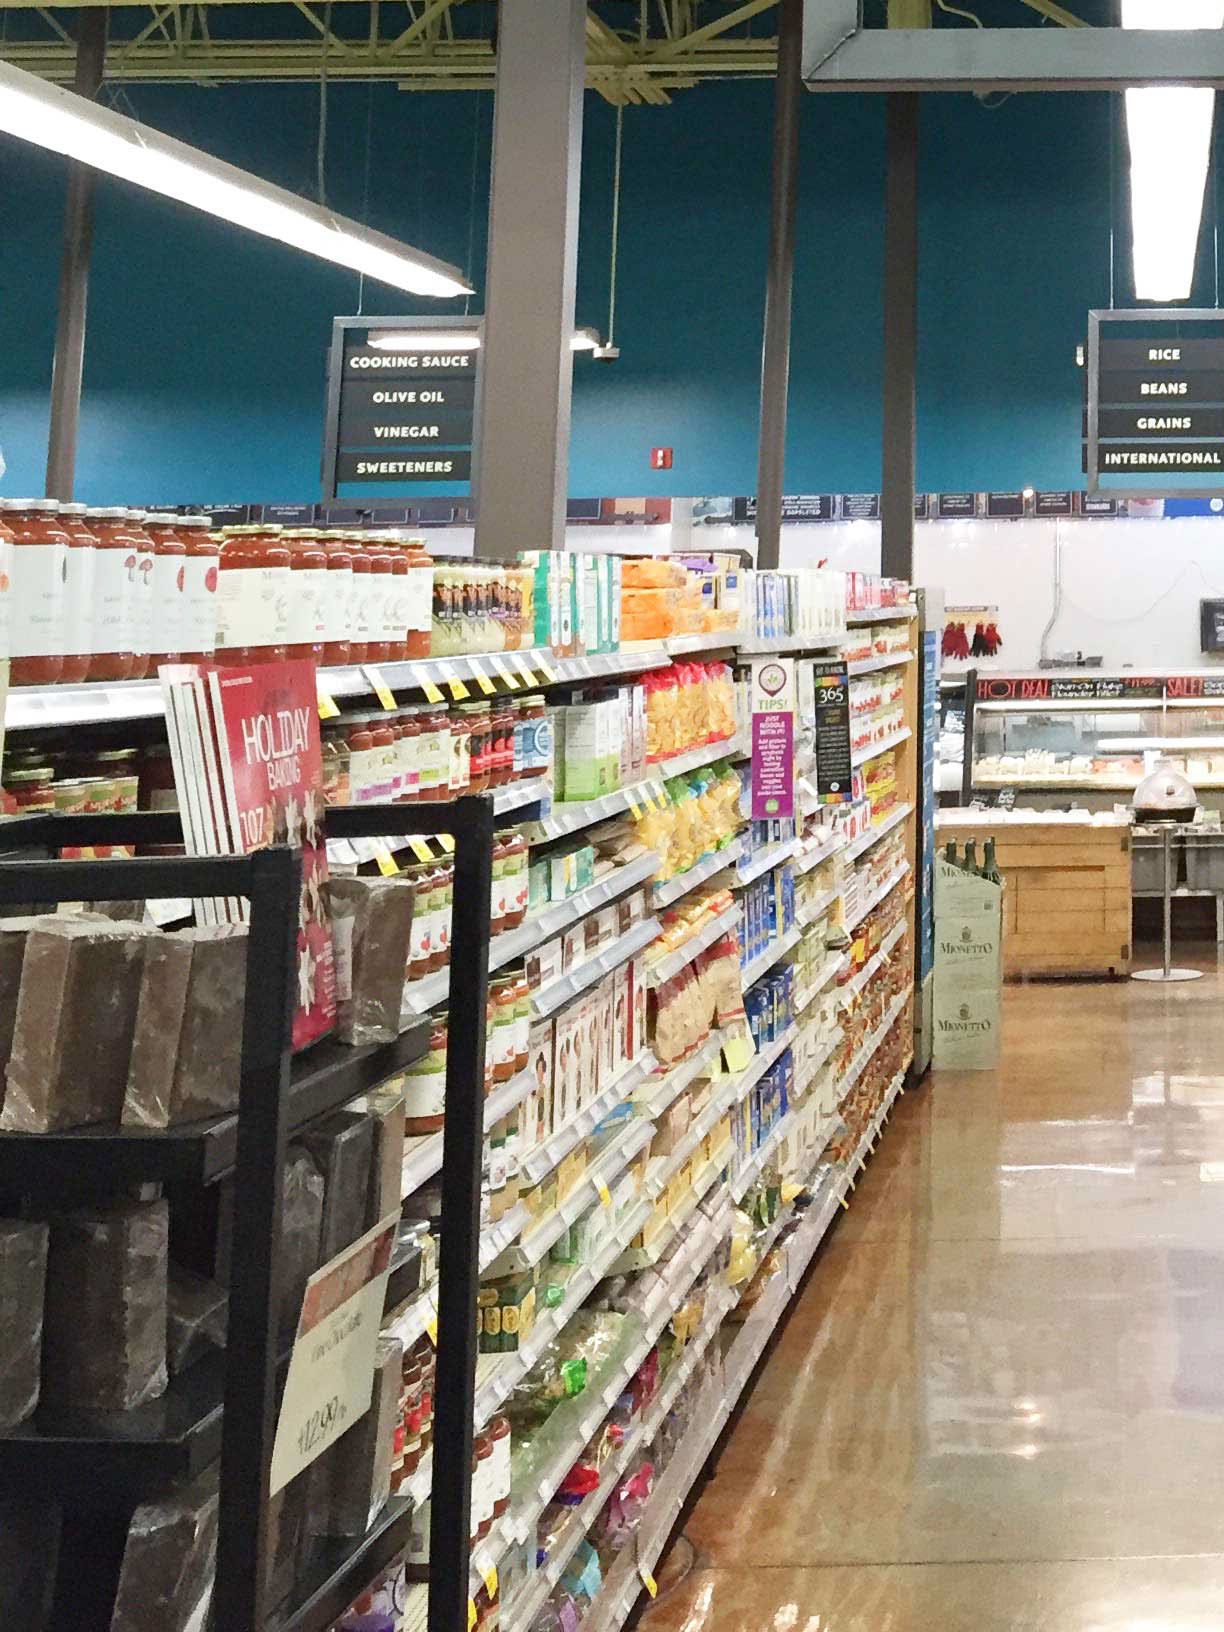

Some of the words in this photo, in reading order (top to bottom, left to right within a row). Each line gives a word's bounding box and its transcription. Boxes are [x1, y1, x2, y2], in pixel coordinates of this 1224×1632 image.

[349, 355, 420, 370] COOKING
[421, 354, 470, 369] SAUCE
[1148, 348, 1181, 362] RICE
[1140, 382, 1188, 396] BEANS
[372, 390, 417, 405] OLIVE
[419, 390, 446, 404] OIL
[1136, 416, 1192, 431] GRAINS
[373, 425, 440, 439] VINEGAR
[1104, 451, 1222, 466] INTERNATIONAL
[356, 460, 454, 475] SWEETENERS
[818, 687, 844, 704] 365
[978, 680, 1016, 698] HOT
[758, 699, 788, 710] TIPS!
[241, 706, 310, 765] HOLIDAY
[266, 755, 301, 791] BAKING
[239, 807, 265, 846] 107
[939, 942, 993, 955] MIONETTO
